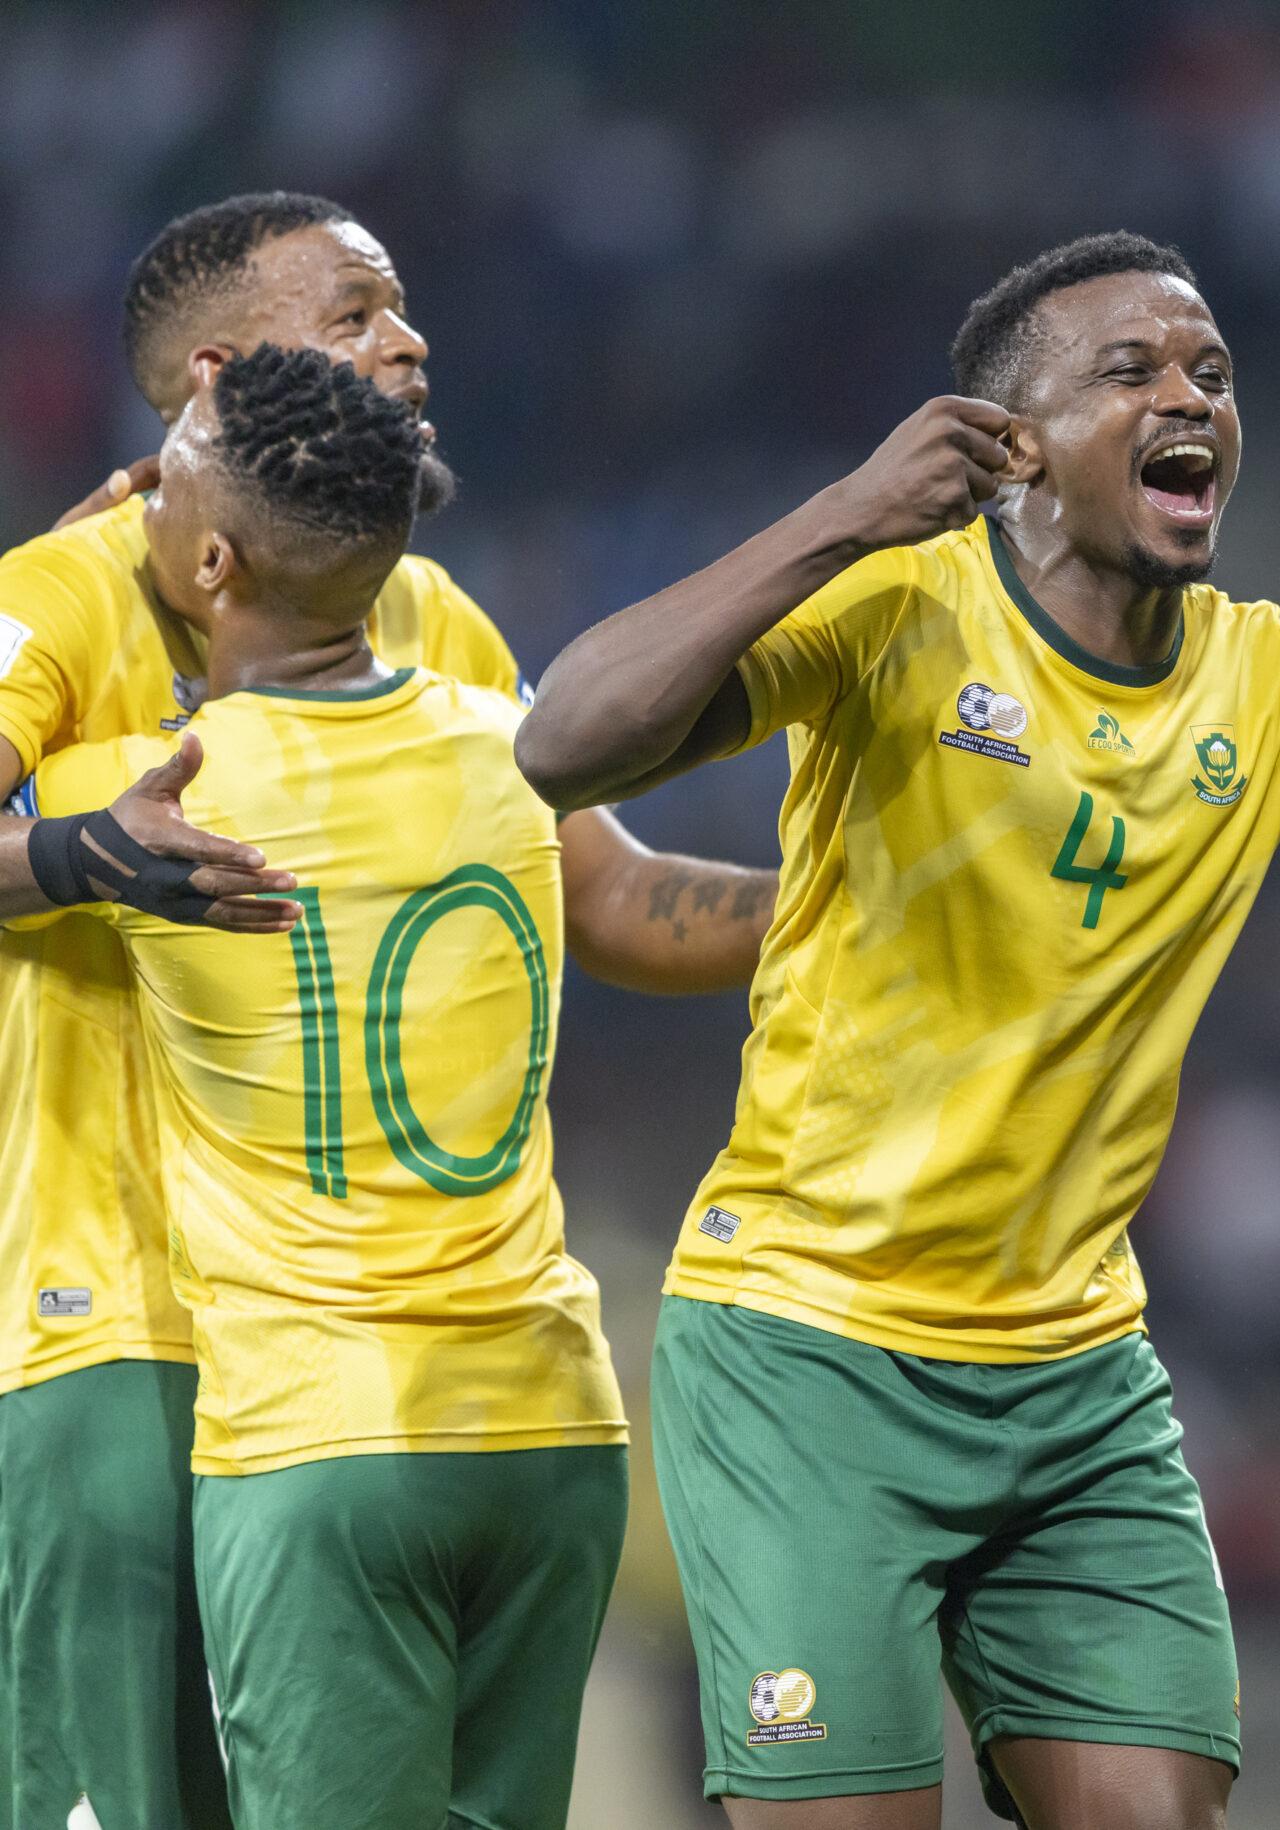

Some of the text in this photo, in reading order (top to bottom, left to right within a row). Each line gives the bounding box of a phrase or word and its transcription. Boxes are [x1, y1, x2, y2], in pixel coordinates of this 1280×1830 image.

[941, 735, 1029, 765] FOOTBALL ASSOCIATION
[958, 732, 1017, 753] SOUTH AFRICAN
[1199, 791, 1241, 804] SOUTH AFRICA
[1050, 790, 1129, 929] 4
[256, 863, 550, 1199] 10
[749, 1729, 823, 1742] FOOTBALL ASSOCIATION
[759, 1723, 808, 1734] SOUTH AFRICAN
